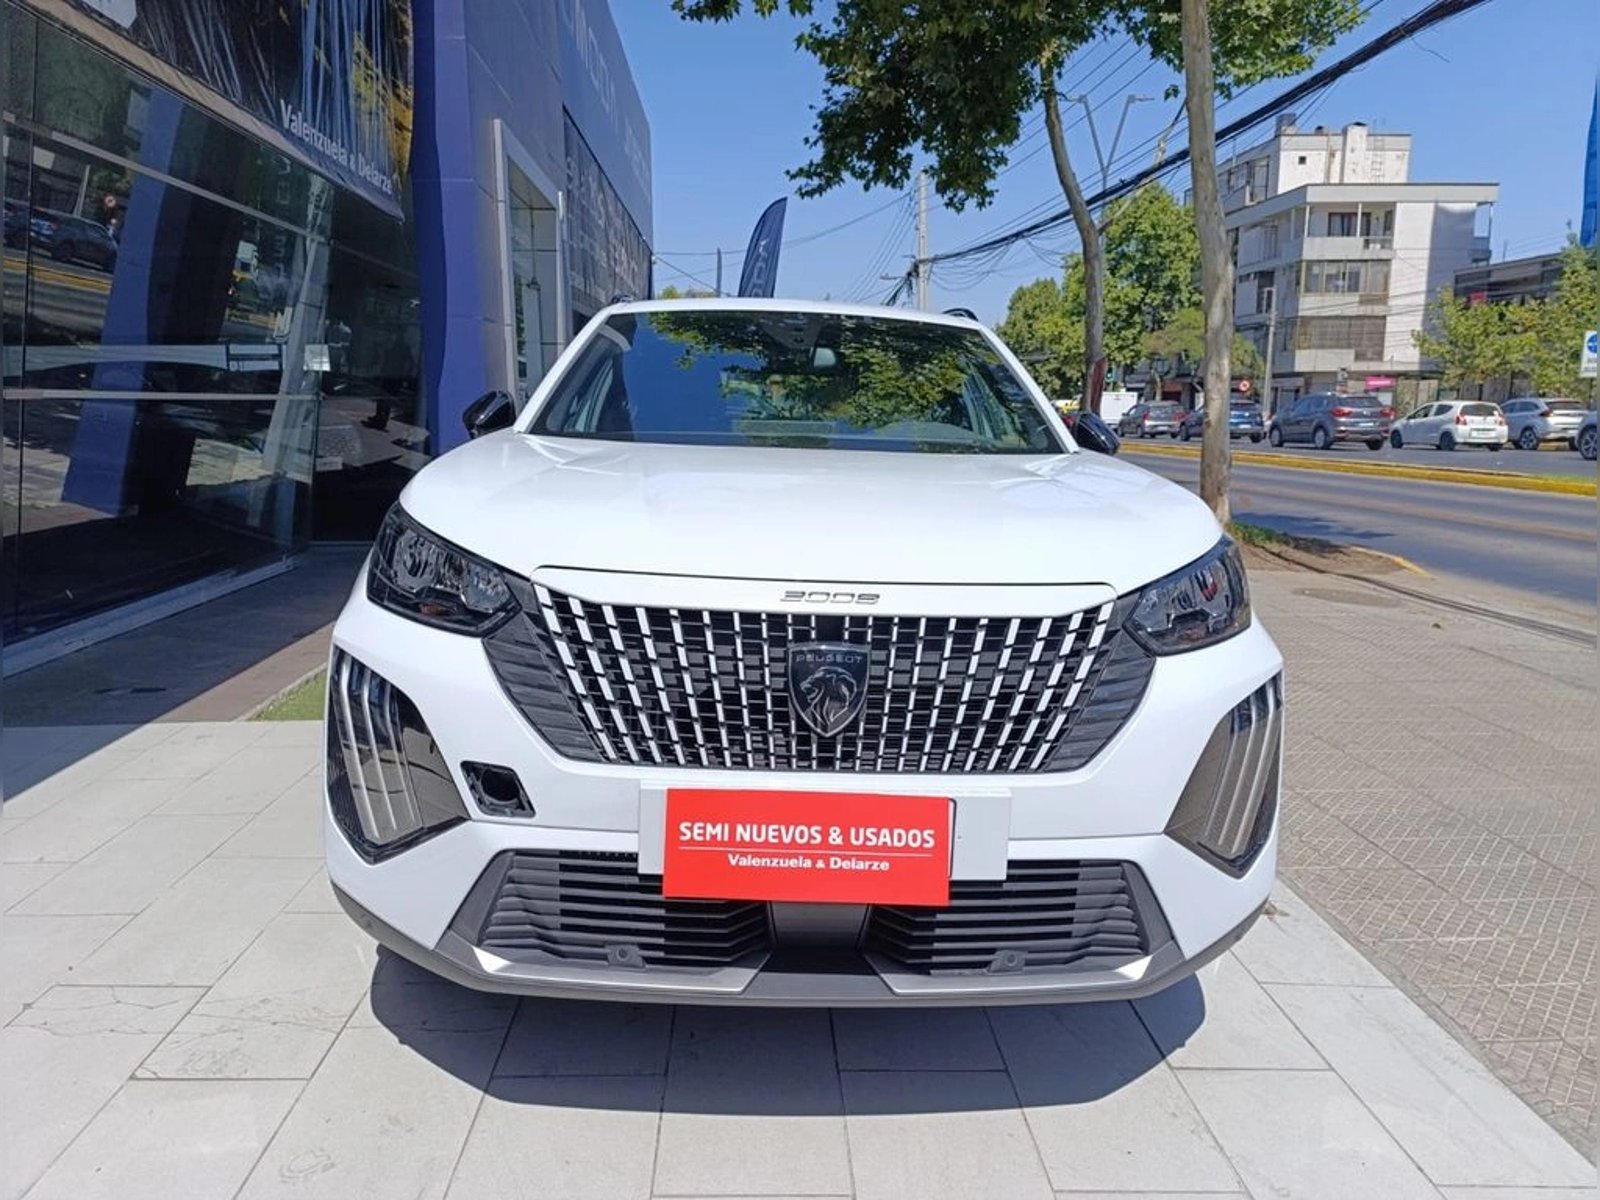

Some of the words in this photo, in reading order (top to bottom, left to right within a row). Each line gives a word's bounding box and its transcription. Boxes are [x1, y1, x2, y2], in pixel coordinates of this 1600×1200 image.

[280, 99, 348, 167] Valenzuela
[359, 151, 393, 195] Delarze
[780, 591, 880, 605] 2008
[796, 653, 863, 663] PEUGEOT
[679, 822, 729, 842] SEMI
[735, 824, 822, 845] NUEVOS
[828, 827, 844, 846] &
[850, 828, 935, 848] USADOS
[727, 853, 812, 869] Valenzuela
[816, 860, 825, 869] &
[829, 857, 889, 871] Delarze
